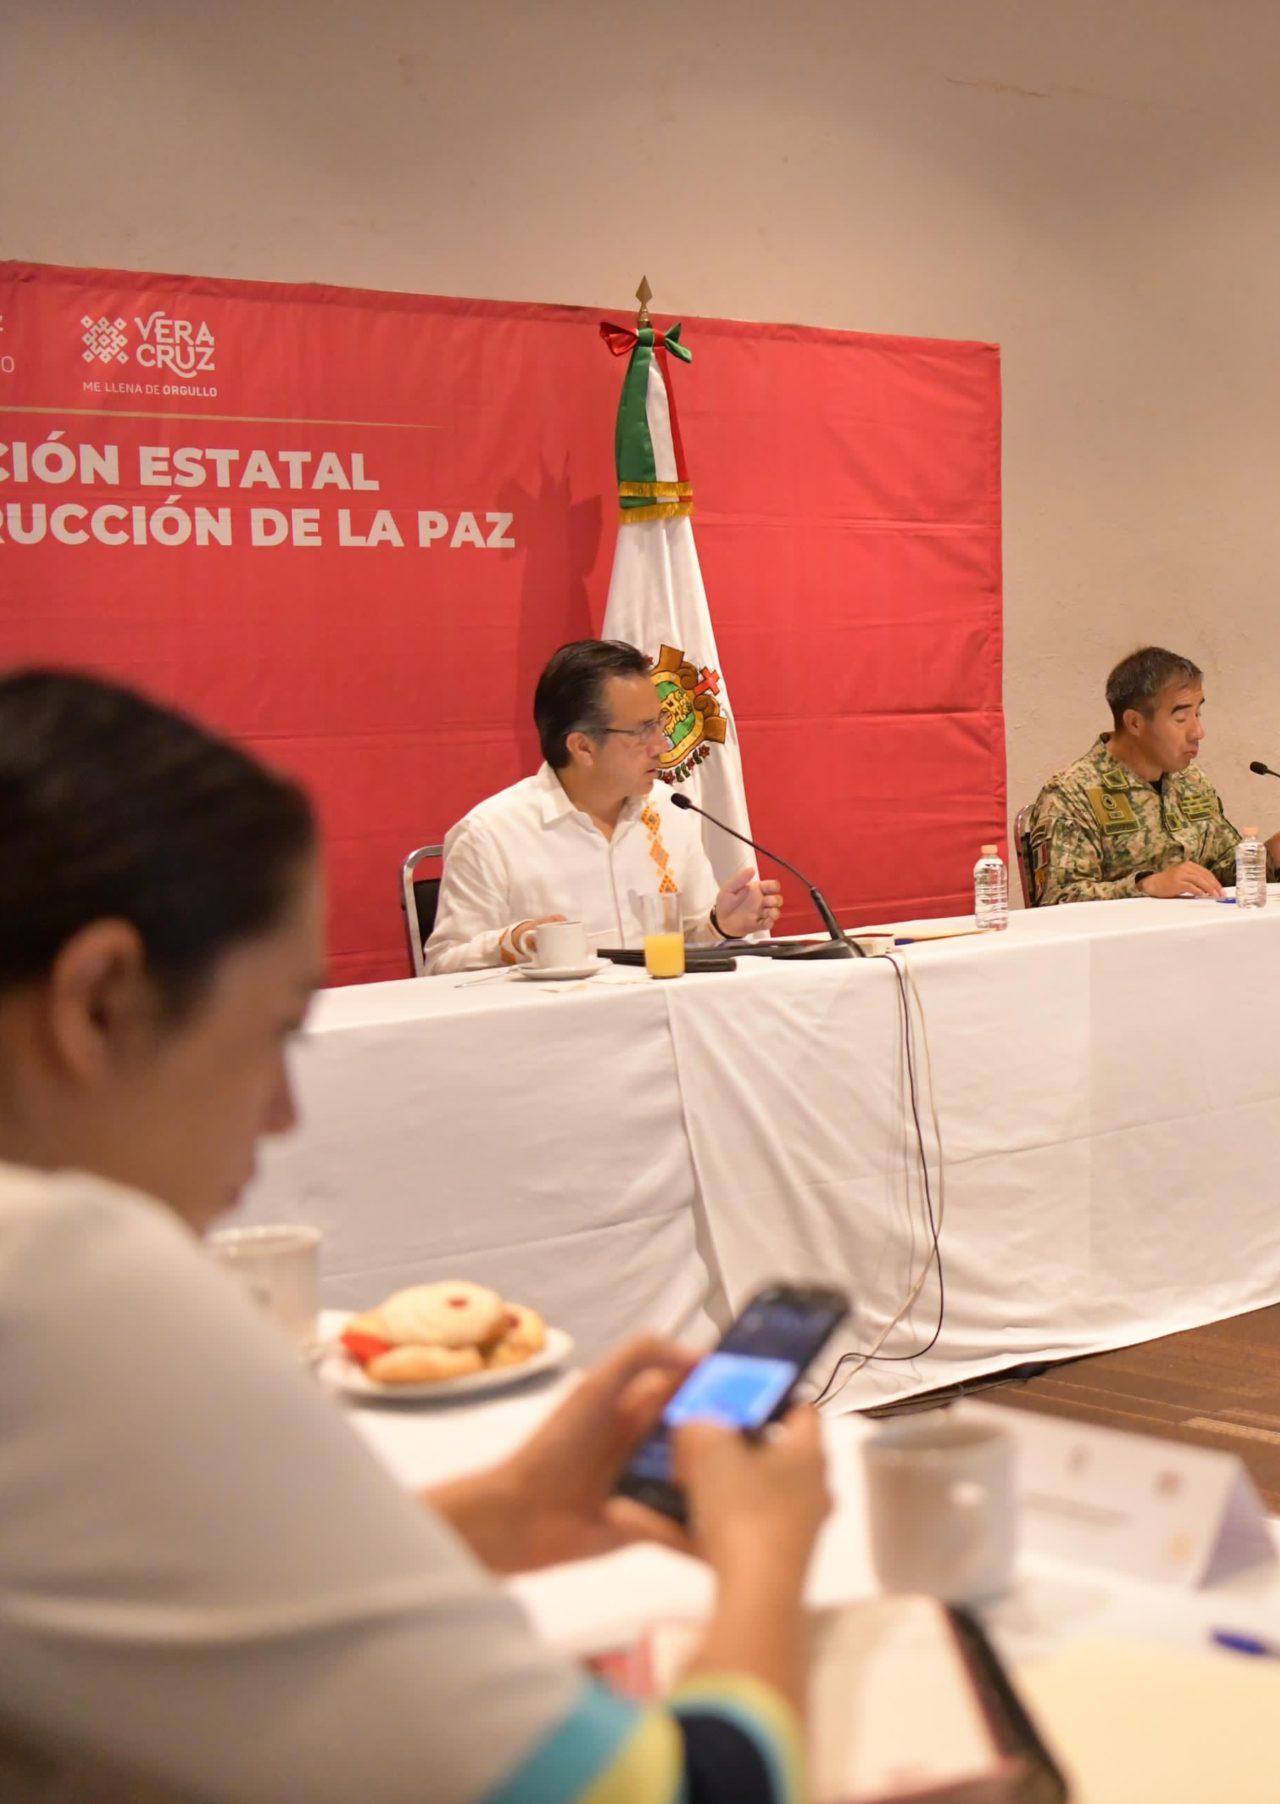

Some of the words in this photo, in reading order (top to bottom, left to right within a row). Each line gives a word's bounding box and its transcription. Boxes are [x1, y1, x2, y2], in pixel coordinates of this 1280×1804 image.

[134, 311, 215, 345] VERA
[136, 343, 215, 378] CRUZ
[83, 382, 100, 392] ME
[104, 383, 142, 394] LLENA
[146, 384, 160, 395] DE
[163, 385, 218, 397] ORGULLO
[0, 430, 120, 485] IÓN
[139, 446, 380, 491] ESTATAL
[0, 495, 232, 546] UCCIÓN
[250, 508, 322, 546] DE
[337, 509, 405, 547] LA
[417, 511, 515, 548] PAZ
